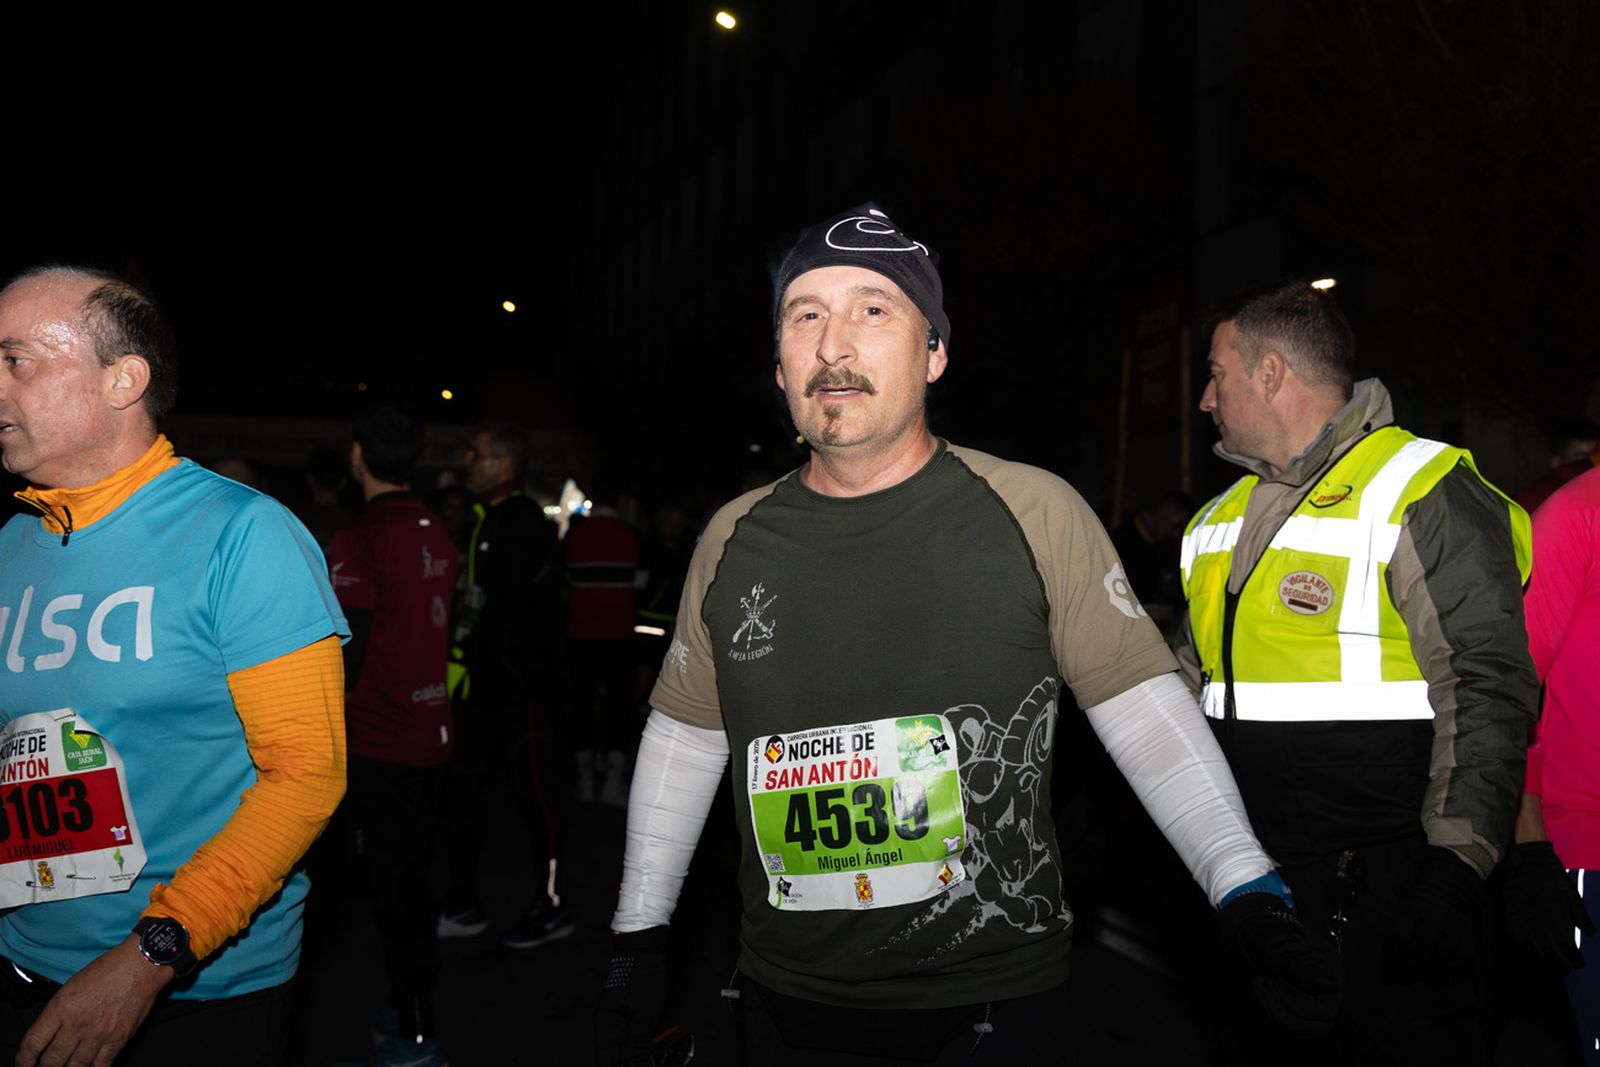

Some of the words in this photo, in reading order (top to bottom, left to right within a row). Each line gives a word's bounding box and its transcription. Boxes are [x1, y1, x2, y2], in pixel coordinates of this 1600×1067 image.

[1286, 574, 1330, 594] VIGILANTE
[1282, 586, 1328, 606] SEGURIDAD
[0, 585, 155, 672] lsa
[28, 735, 47, 754] DE
[808, 728, 829, 739] URBANA
[788, 736, 846, 762] NOCHE
[851, 732, 875, 753] DE
[764, 766, 804, 791] SAN
[808, 753, 878, 786] ANTÓN
[817, 853, 861, 872] Miguel
[865, 848, 903, 869] Ángel
